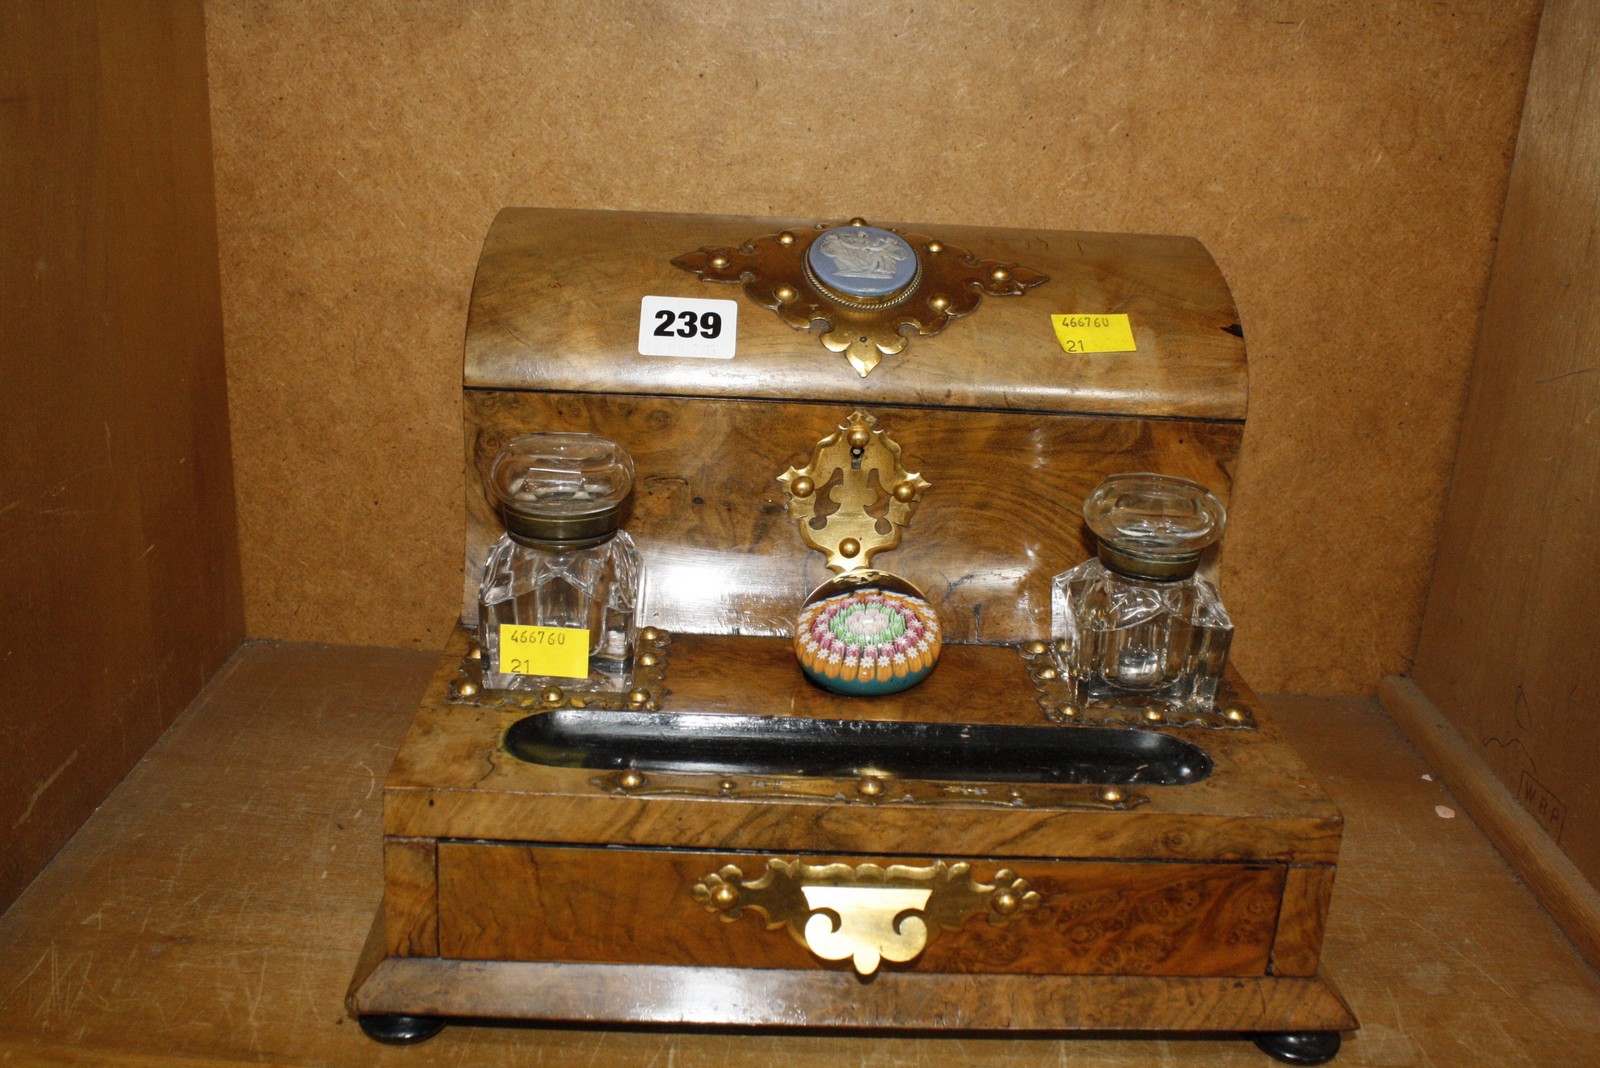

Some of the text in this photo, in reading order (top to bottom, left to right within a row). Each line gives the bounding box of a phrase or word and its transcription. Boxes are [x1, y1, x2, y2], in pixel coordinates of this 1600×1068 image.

[653, 309, 722, 340] 239
[1062, 317, 1109, 328] 466760
[1066, 340, 1085, 352] 21
[511, 630, 565, 645] 466760
[510, 658, 530, 673] 21
